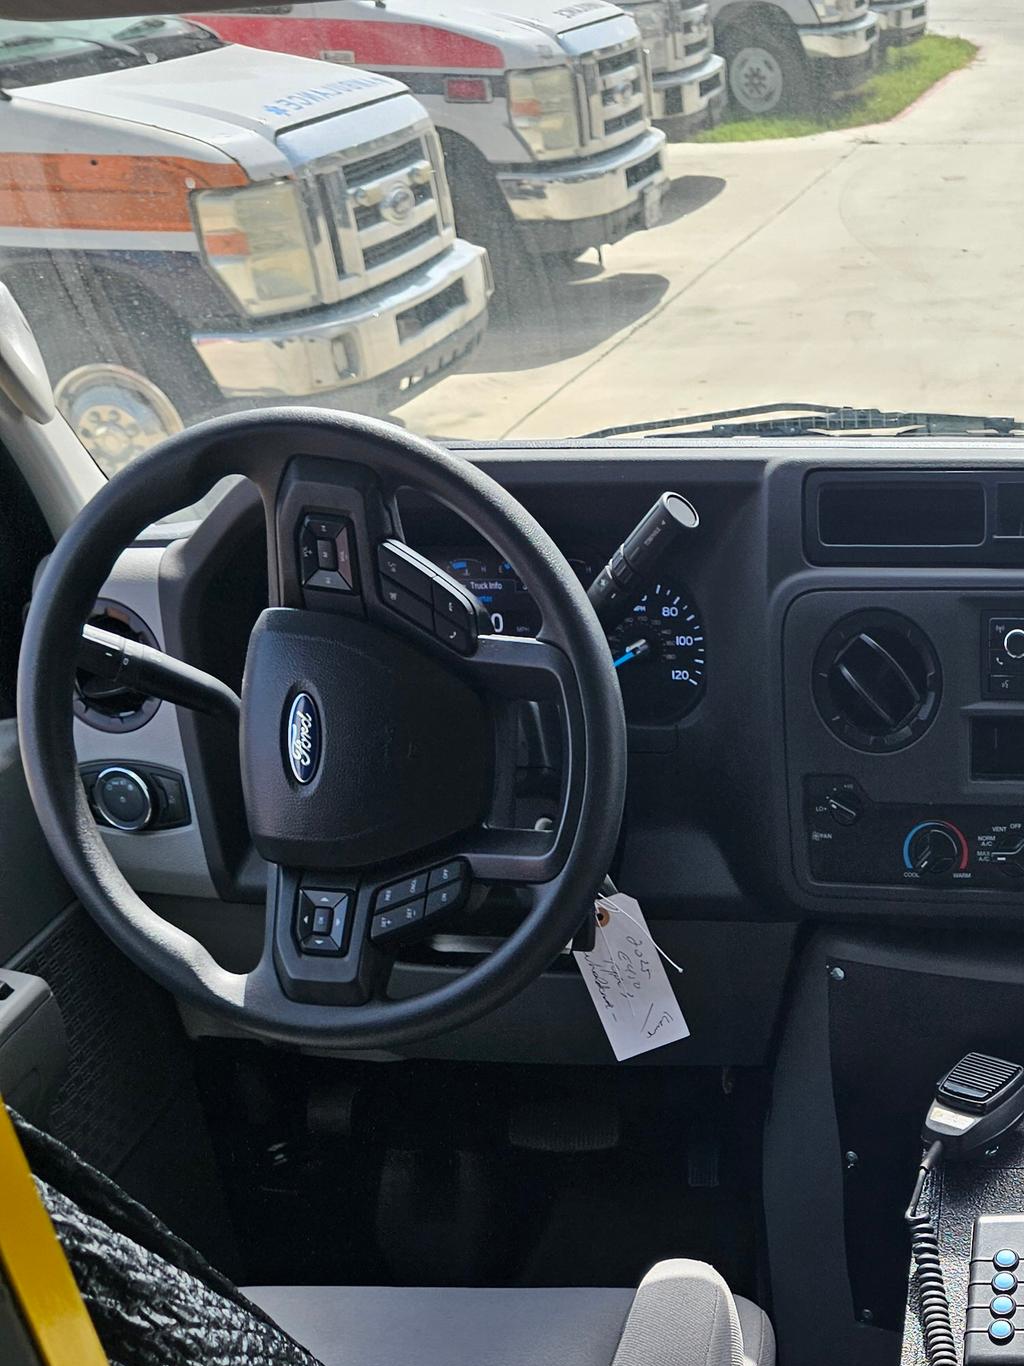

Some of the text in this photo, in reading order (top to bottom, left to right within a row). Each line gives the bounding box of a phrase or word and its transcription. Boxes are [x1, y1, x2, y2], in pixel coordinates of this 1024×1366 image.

[662, 607, 678, 616] 80
[491, 613, 503, 633] 0
[675, 636, 693, 646] 100
[671, 670, 689, 680] 120
[292, 710, 312, 766] Ford
